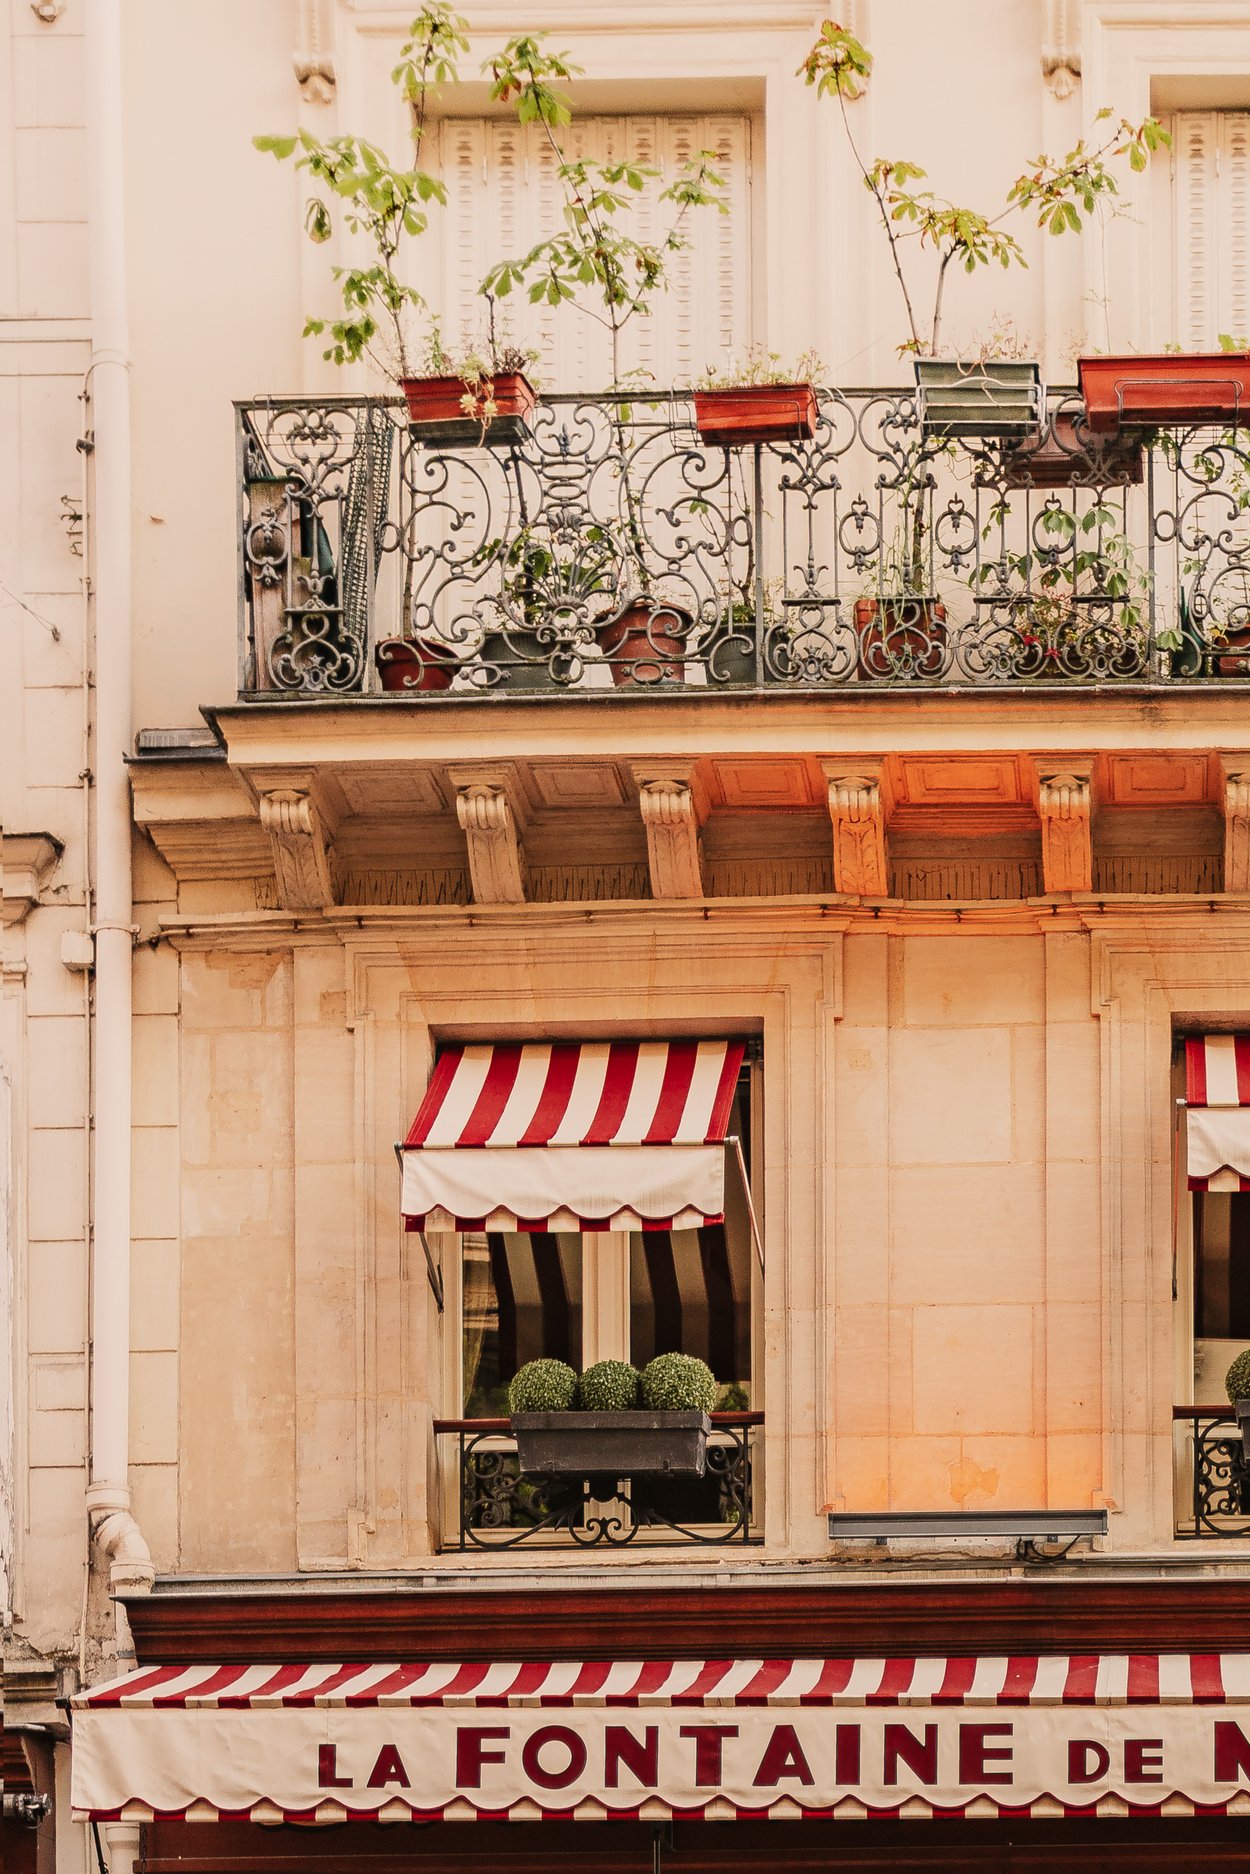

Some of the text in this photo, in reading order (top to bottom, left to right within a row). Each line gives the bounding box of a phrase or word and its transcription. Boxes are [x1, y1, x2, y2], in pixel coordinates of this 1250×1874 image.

[318, 1743, 412, 1788] LA
[455, 1723, 1014, 1789] FONTAINE
[1067, 1738, 1164, 1784] DE
